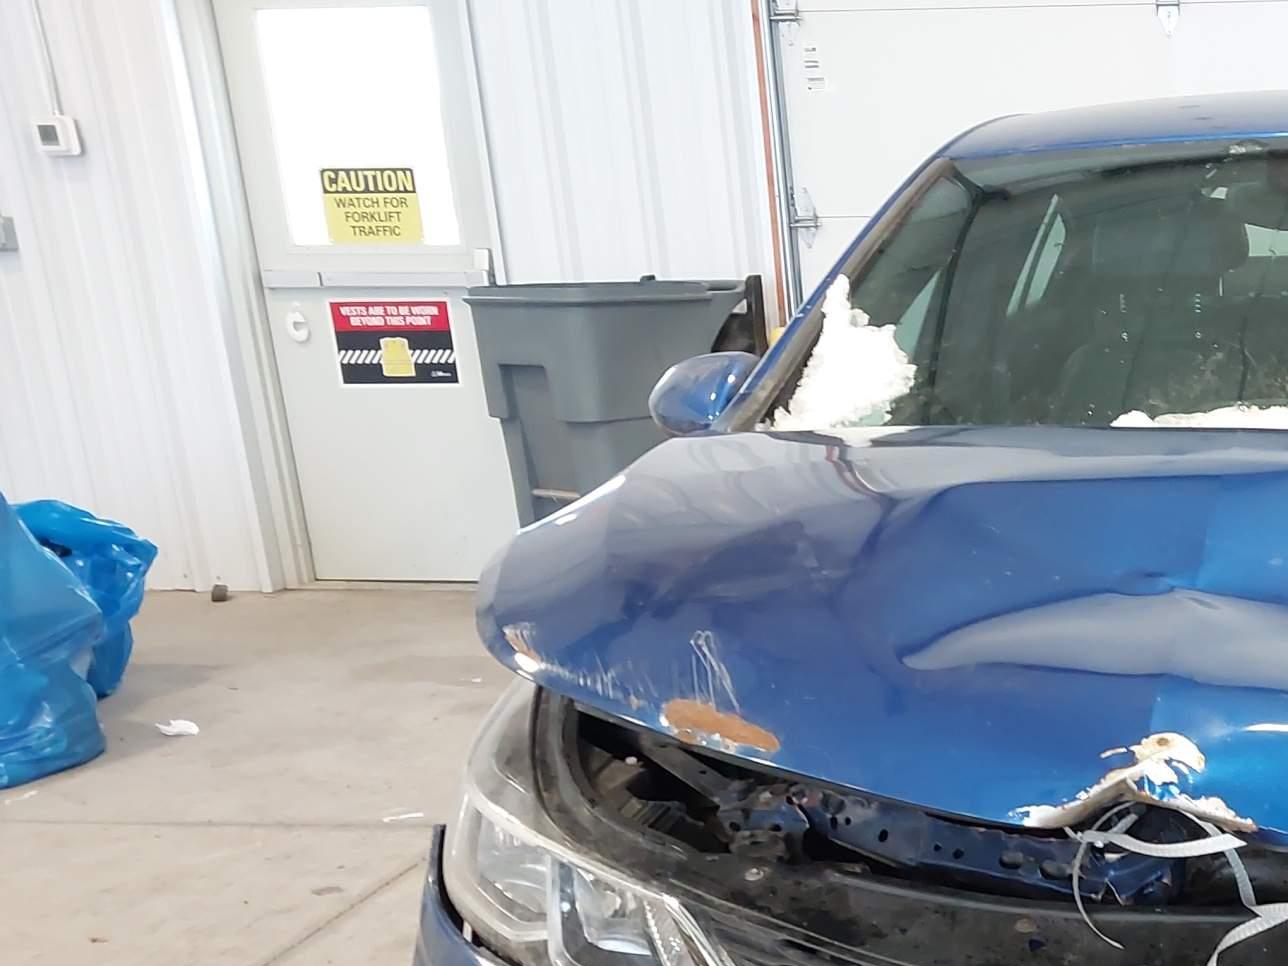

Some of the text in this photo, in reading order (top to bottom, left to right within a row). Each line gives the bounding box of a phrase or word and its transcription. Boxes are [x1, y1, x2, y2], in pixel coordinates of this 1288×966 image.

[322, 170, 414, 192] CAUTION
[334, 196, 409, 208] WATCH FOR
[344, 211, 402, 223] FORKLIFT
[350, 225, 401, 237] TRAFFIC
[339, 305, 367, 316] VESTS
[368, 305, 385, 316] ARE
[385, 305, 398, 315] TO
[349, 315, 432, 326] BEYOND THIS POINT
